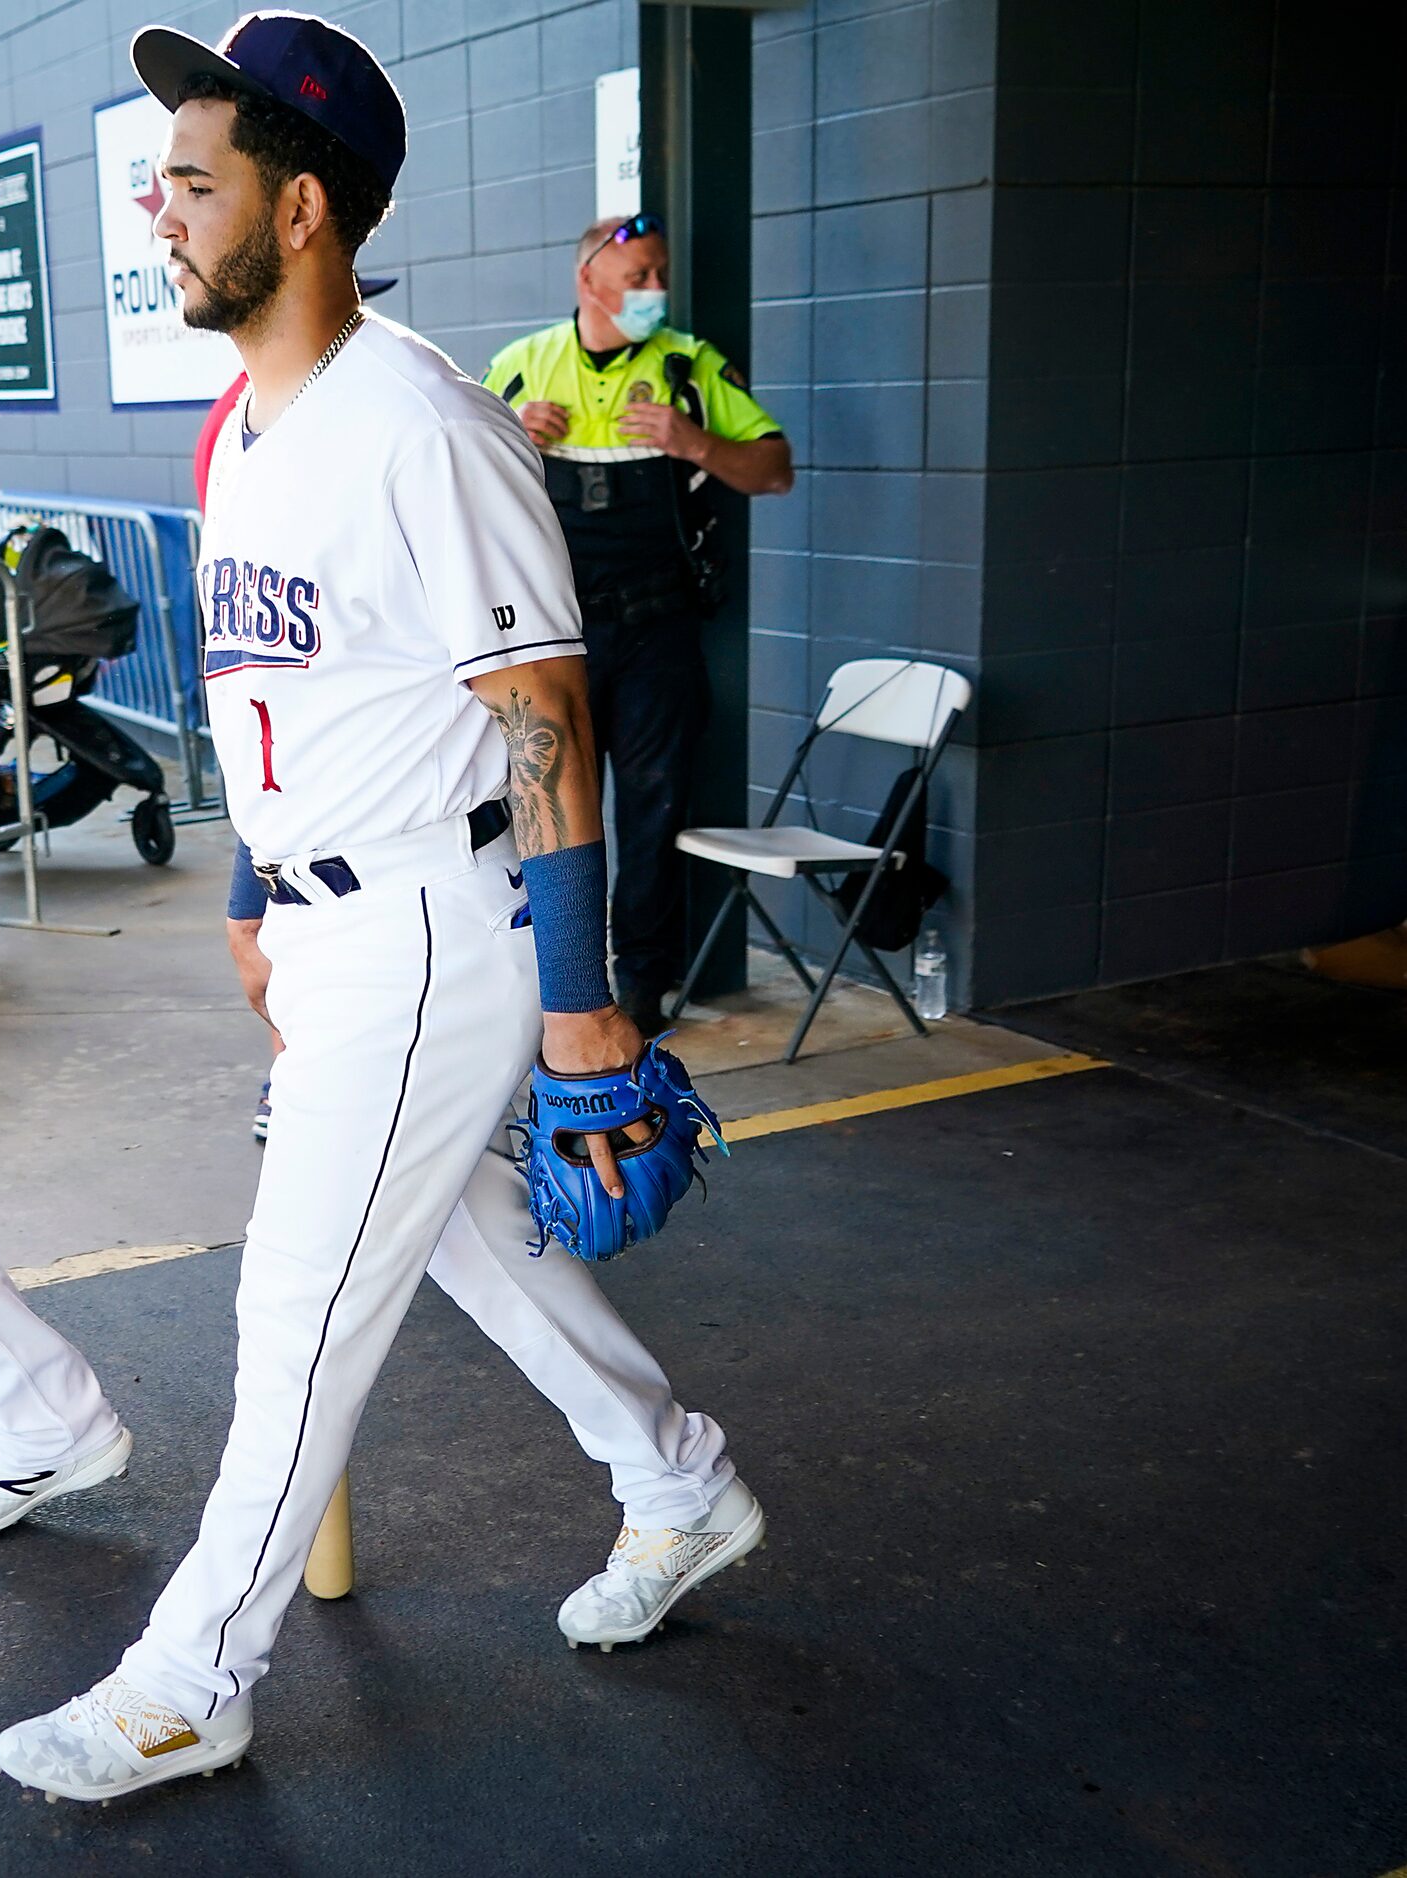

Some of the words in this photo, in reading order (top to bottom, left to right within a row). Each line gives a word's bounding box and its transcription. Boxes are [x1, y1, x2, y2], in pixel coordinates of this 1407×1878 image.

[249, 698, 282, 793] 1
[546, 1093, 617, 1116] Wilson
[139, 1710, 161, 1721] new
